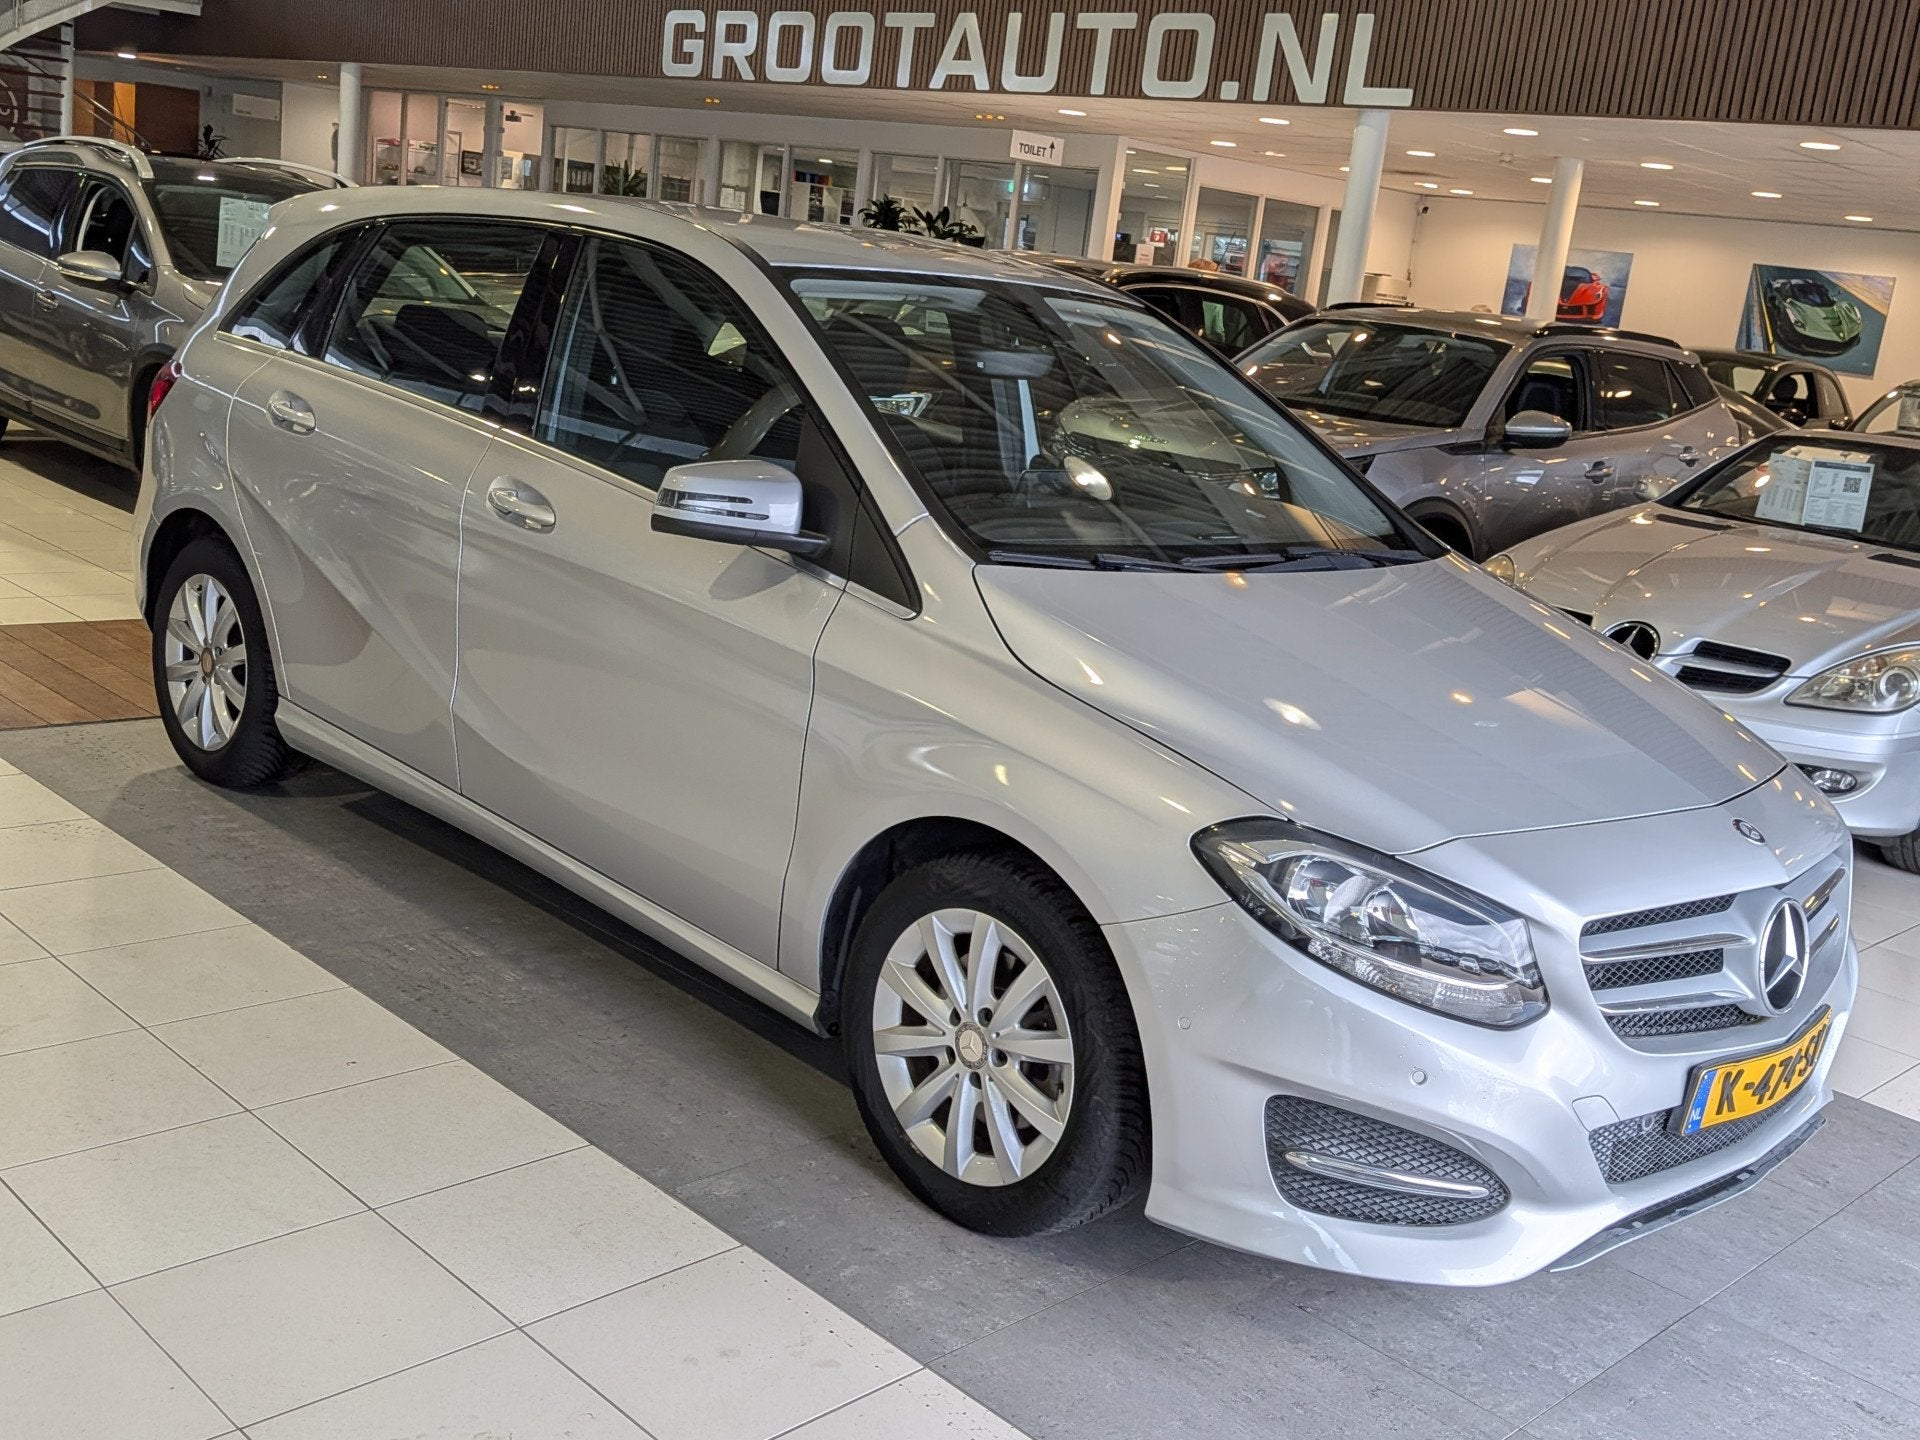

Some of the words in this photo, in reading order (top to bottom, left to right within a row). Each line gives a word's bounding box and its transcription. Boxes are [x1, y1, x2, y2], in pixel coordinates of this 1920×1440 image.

[662, 9, 1413, 107] GROOTAUTO.NL
[1019, 142, 1047, 157] TOILET
[1689, 1106, 1702, 1122] NL
